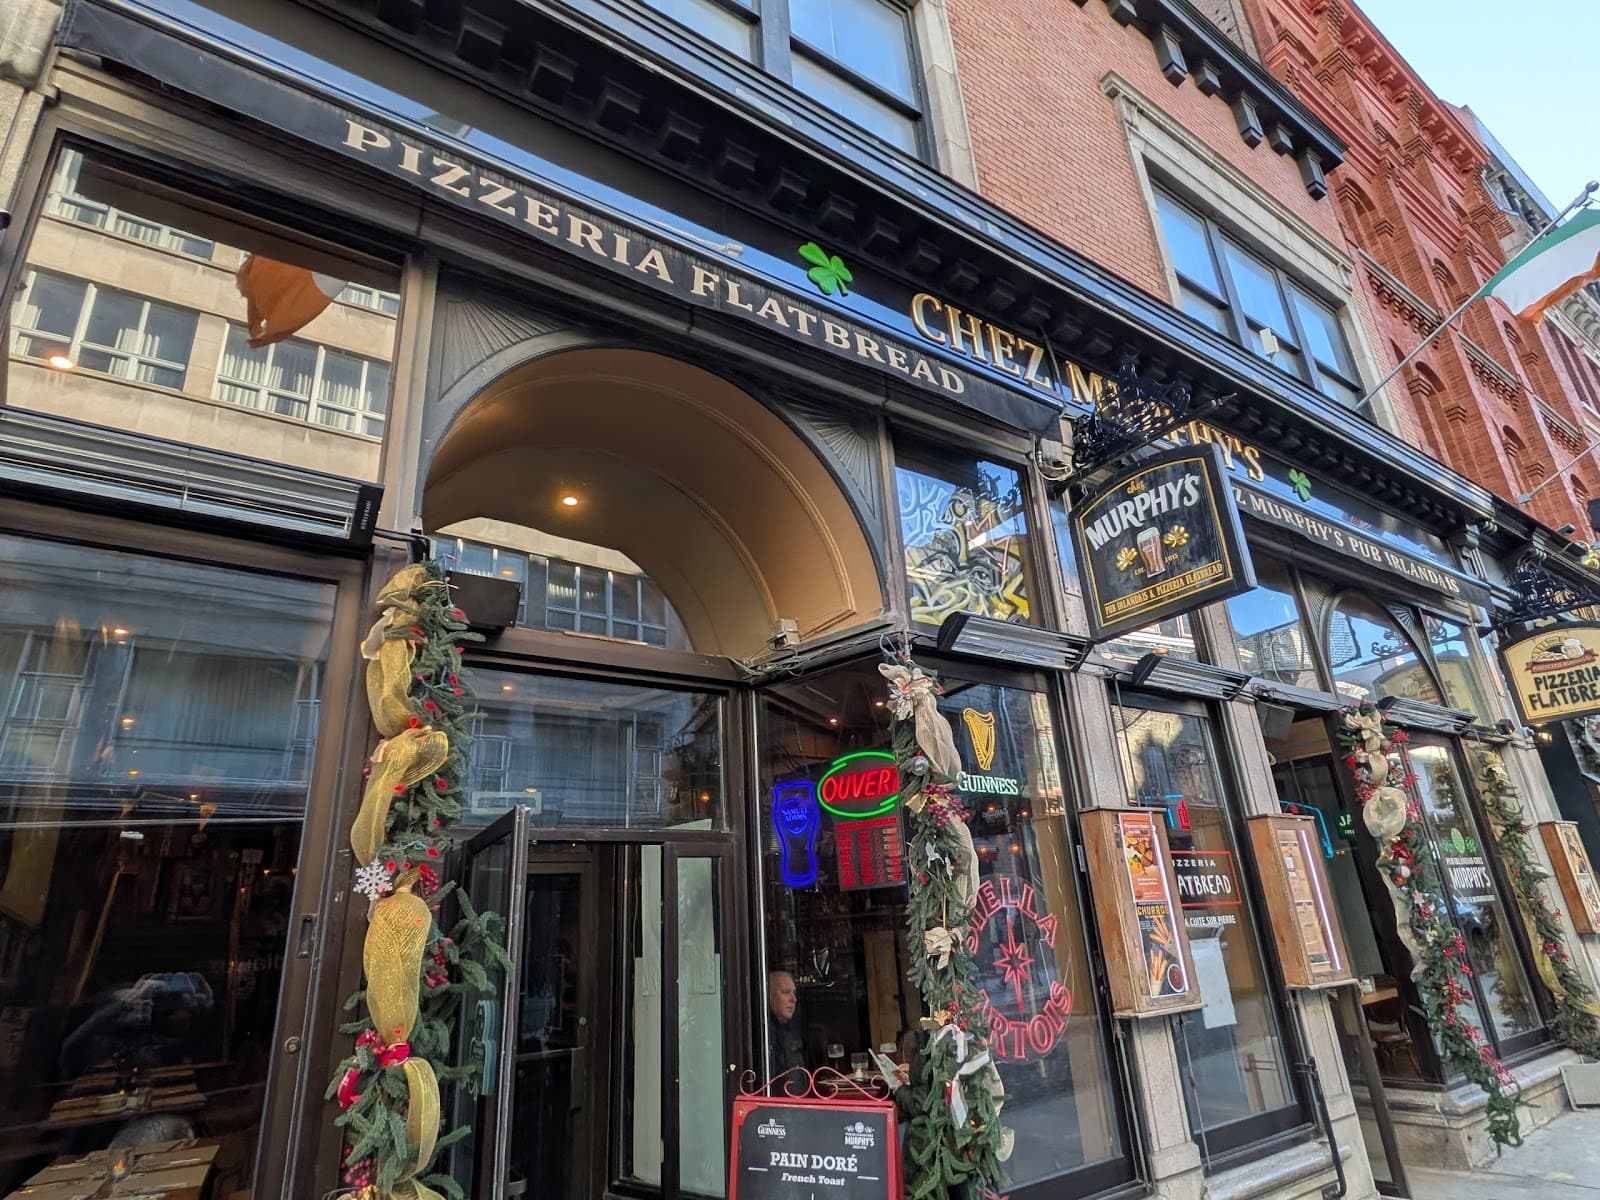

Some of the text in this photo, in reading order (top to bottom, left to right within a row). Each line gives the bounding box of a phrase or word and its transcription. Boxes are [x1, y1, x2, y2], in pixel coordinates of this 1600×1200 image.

[342, 119, 965, 395] PIZZERIA FLATBREAD
[911, 292, 1051, 388] CHEZ
[1085, 473, 1201, 550] MURPHY'S
[1250, 494, 1344, 547] MURPHY'S
[1348, 537, 1382, 562] PUB
[1384, 551, 1459, 593] IRLANDAIS
[1117, 591, 1149, 611] IRLANDAIS
[1156, 579, 1185, 596] PIZZERIA
[1185, 563, 1223, 584] FLATBREAD
[956, 771, 1019, 796] GUINNESS
[1448, 866, 1492, 889] MURPHY'S
[757, 1125, 786, 1136] GUINNESS
[845, 1135, 875, 1147] MURPHY'S
[770, 1151, 858, 1173] PAIN DORÉ
[781, 1172, 845, 1187] French Toast
